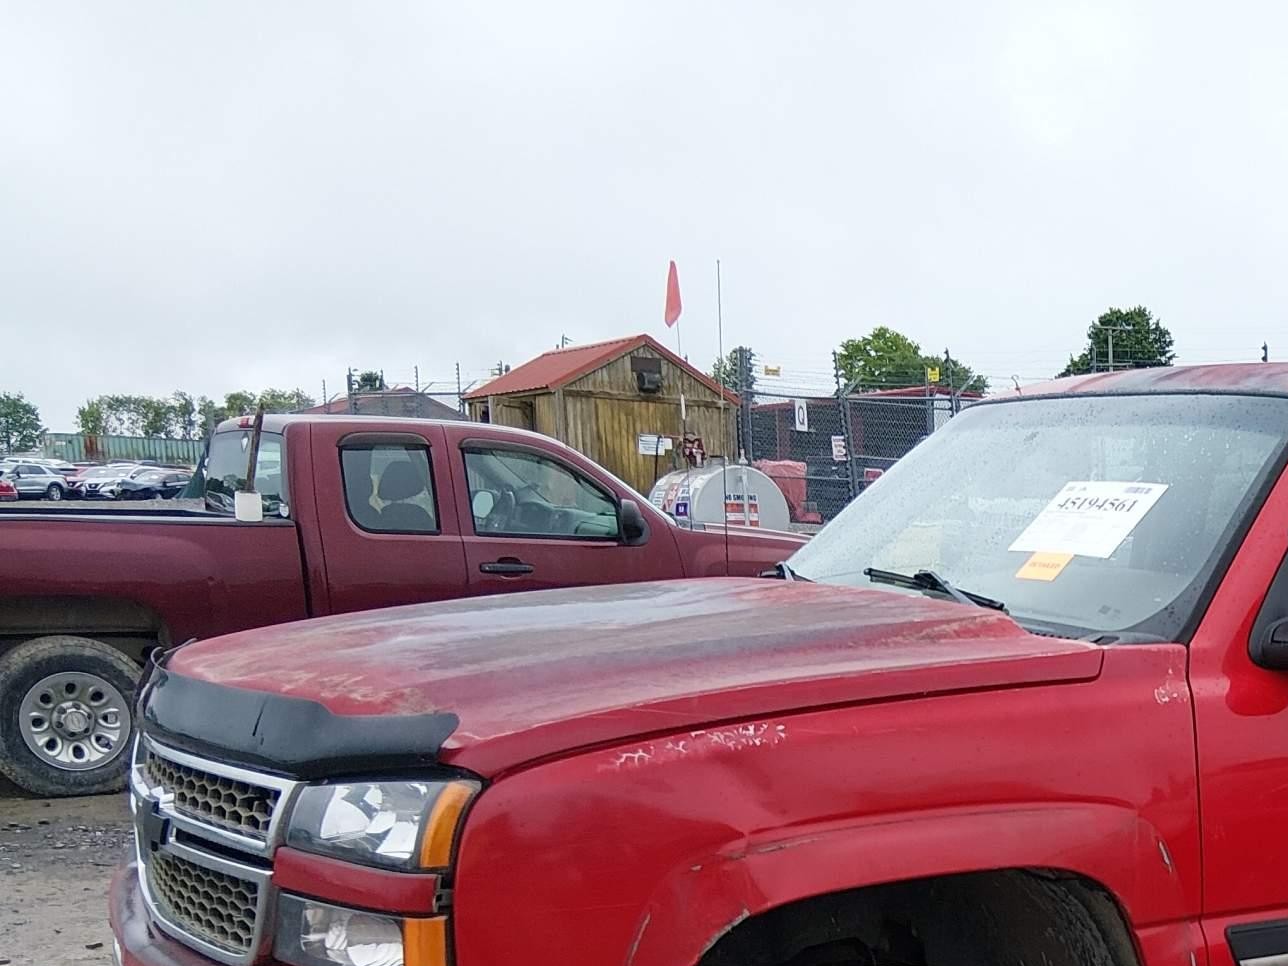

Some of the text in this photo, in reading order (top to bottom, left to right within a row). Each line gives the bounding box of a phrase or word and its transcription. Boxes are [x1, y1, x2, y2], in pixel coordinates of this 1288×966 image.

[797, 404, 806, 426] Q
[733, 494, 757, 502] SMOING
[1057, 497, 1138, 512] 45194561
